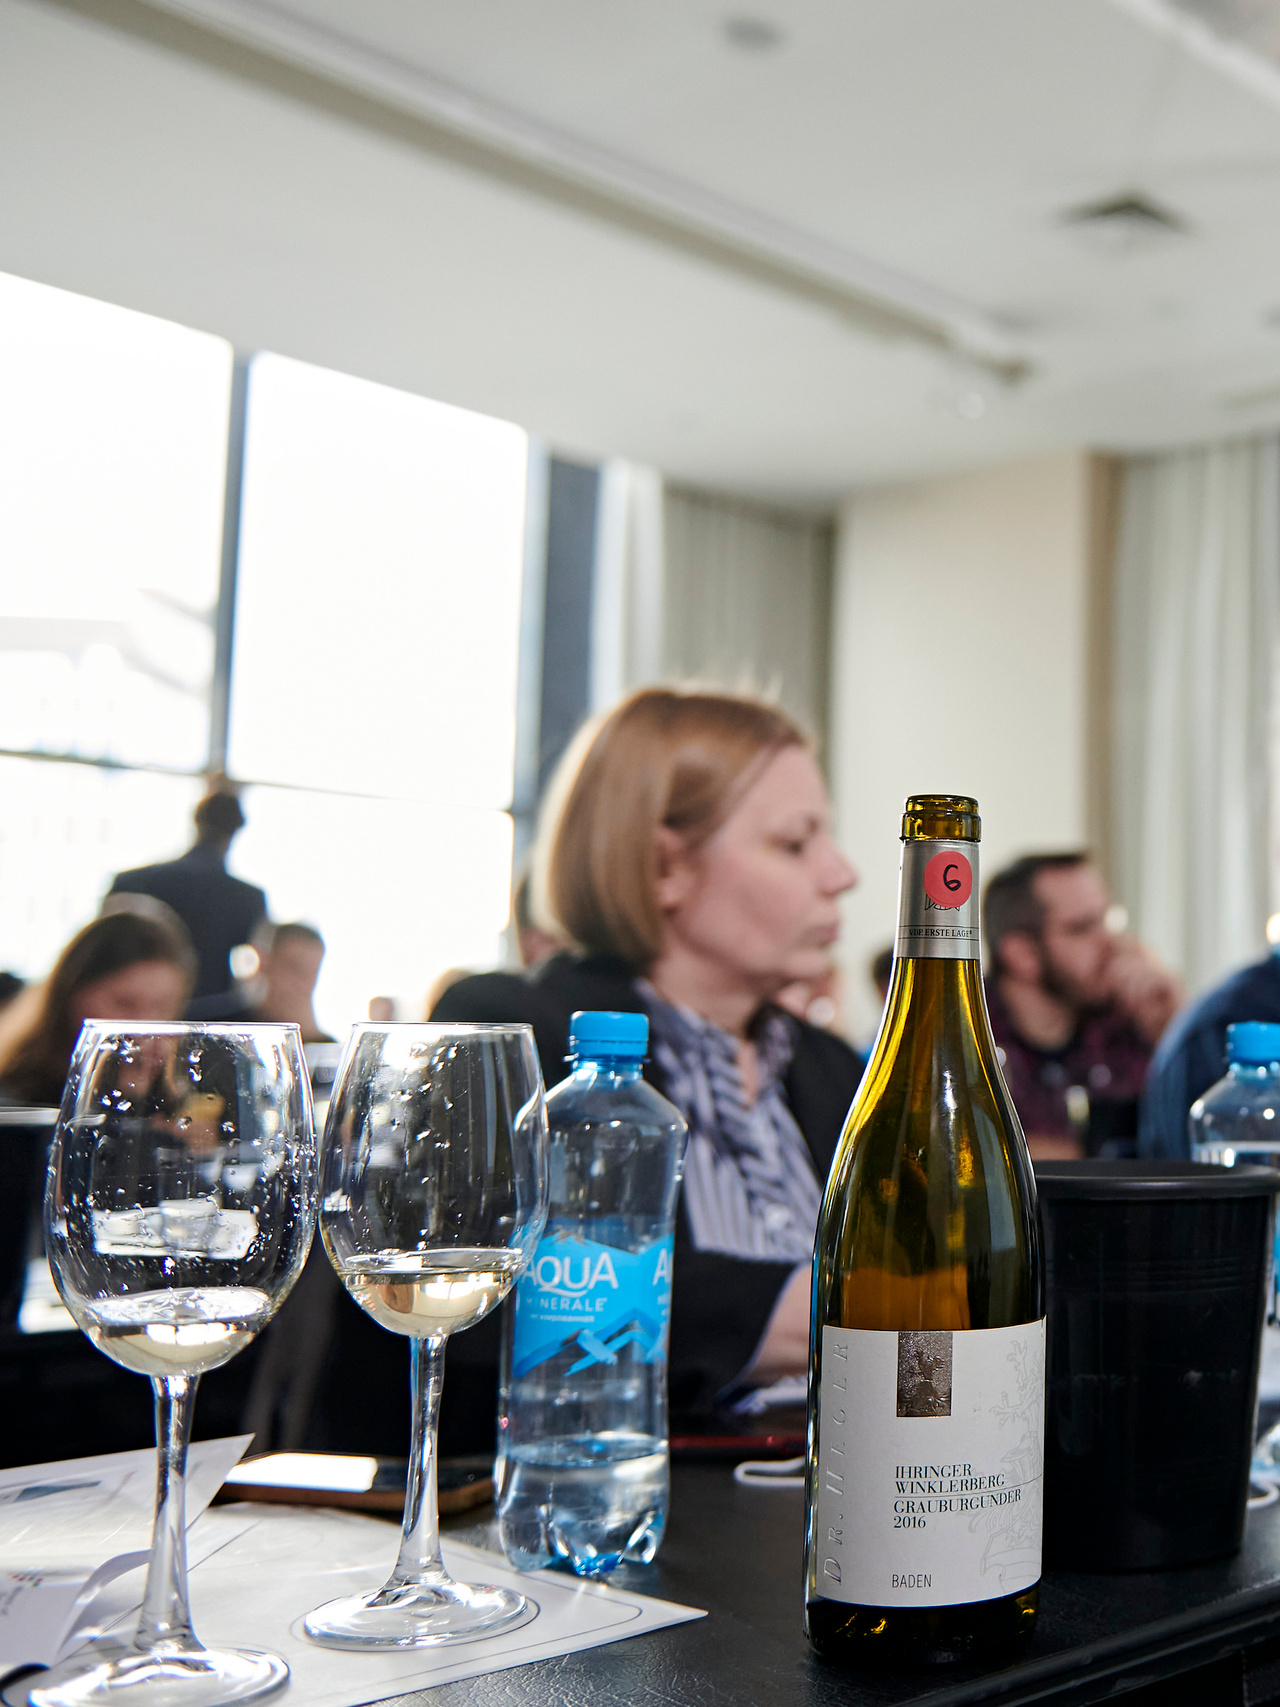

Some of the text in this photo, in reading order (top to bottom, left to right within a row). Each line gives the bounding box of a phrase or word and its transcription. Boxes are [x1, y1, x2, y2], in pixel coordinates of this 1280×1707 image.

[943, 864, 961, 891] 6
[925, 928, 950, 937] ERSTE
[522, 1251, 619, 1298] AQUA
[895, 1463, 972, 1479] IHRINGER
[895, 1473, 1005, 1494] WINKLERBERG
[893, 1489, 1021, 1514] GRAUBURGUNDER
[893, 1515, 927, 1529] 2016
[892, 1573, 932, 1589] BADEN
